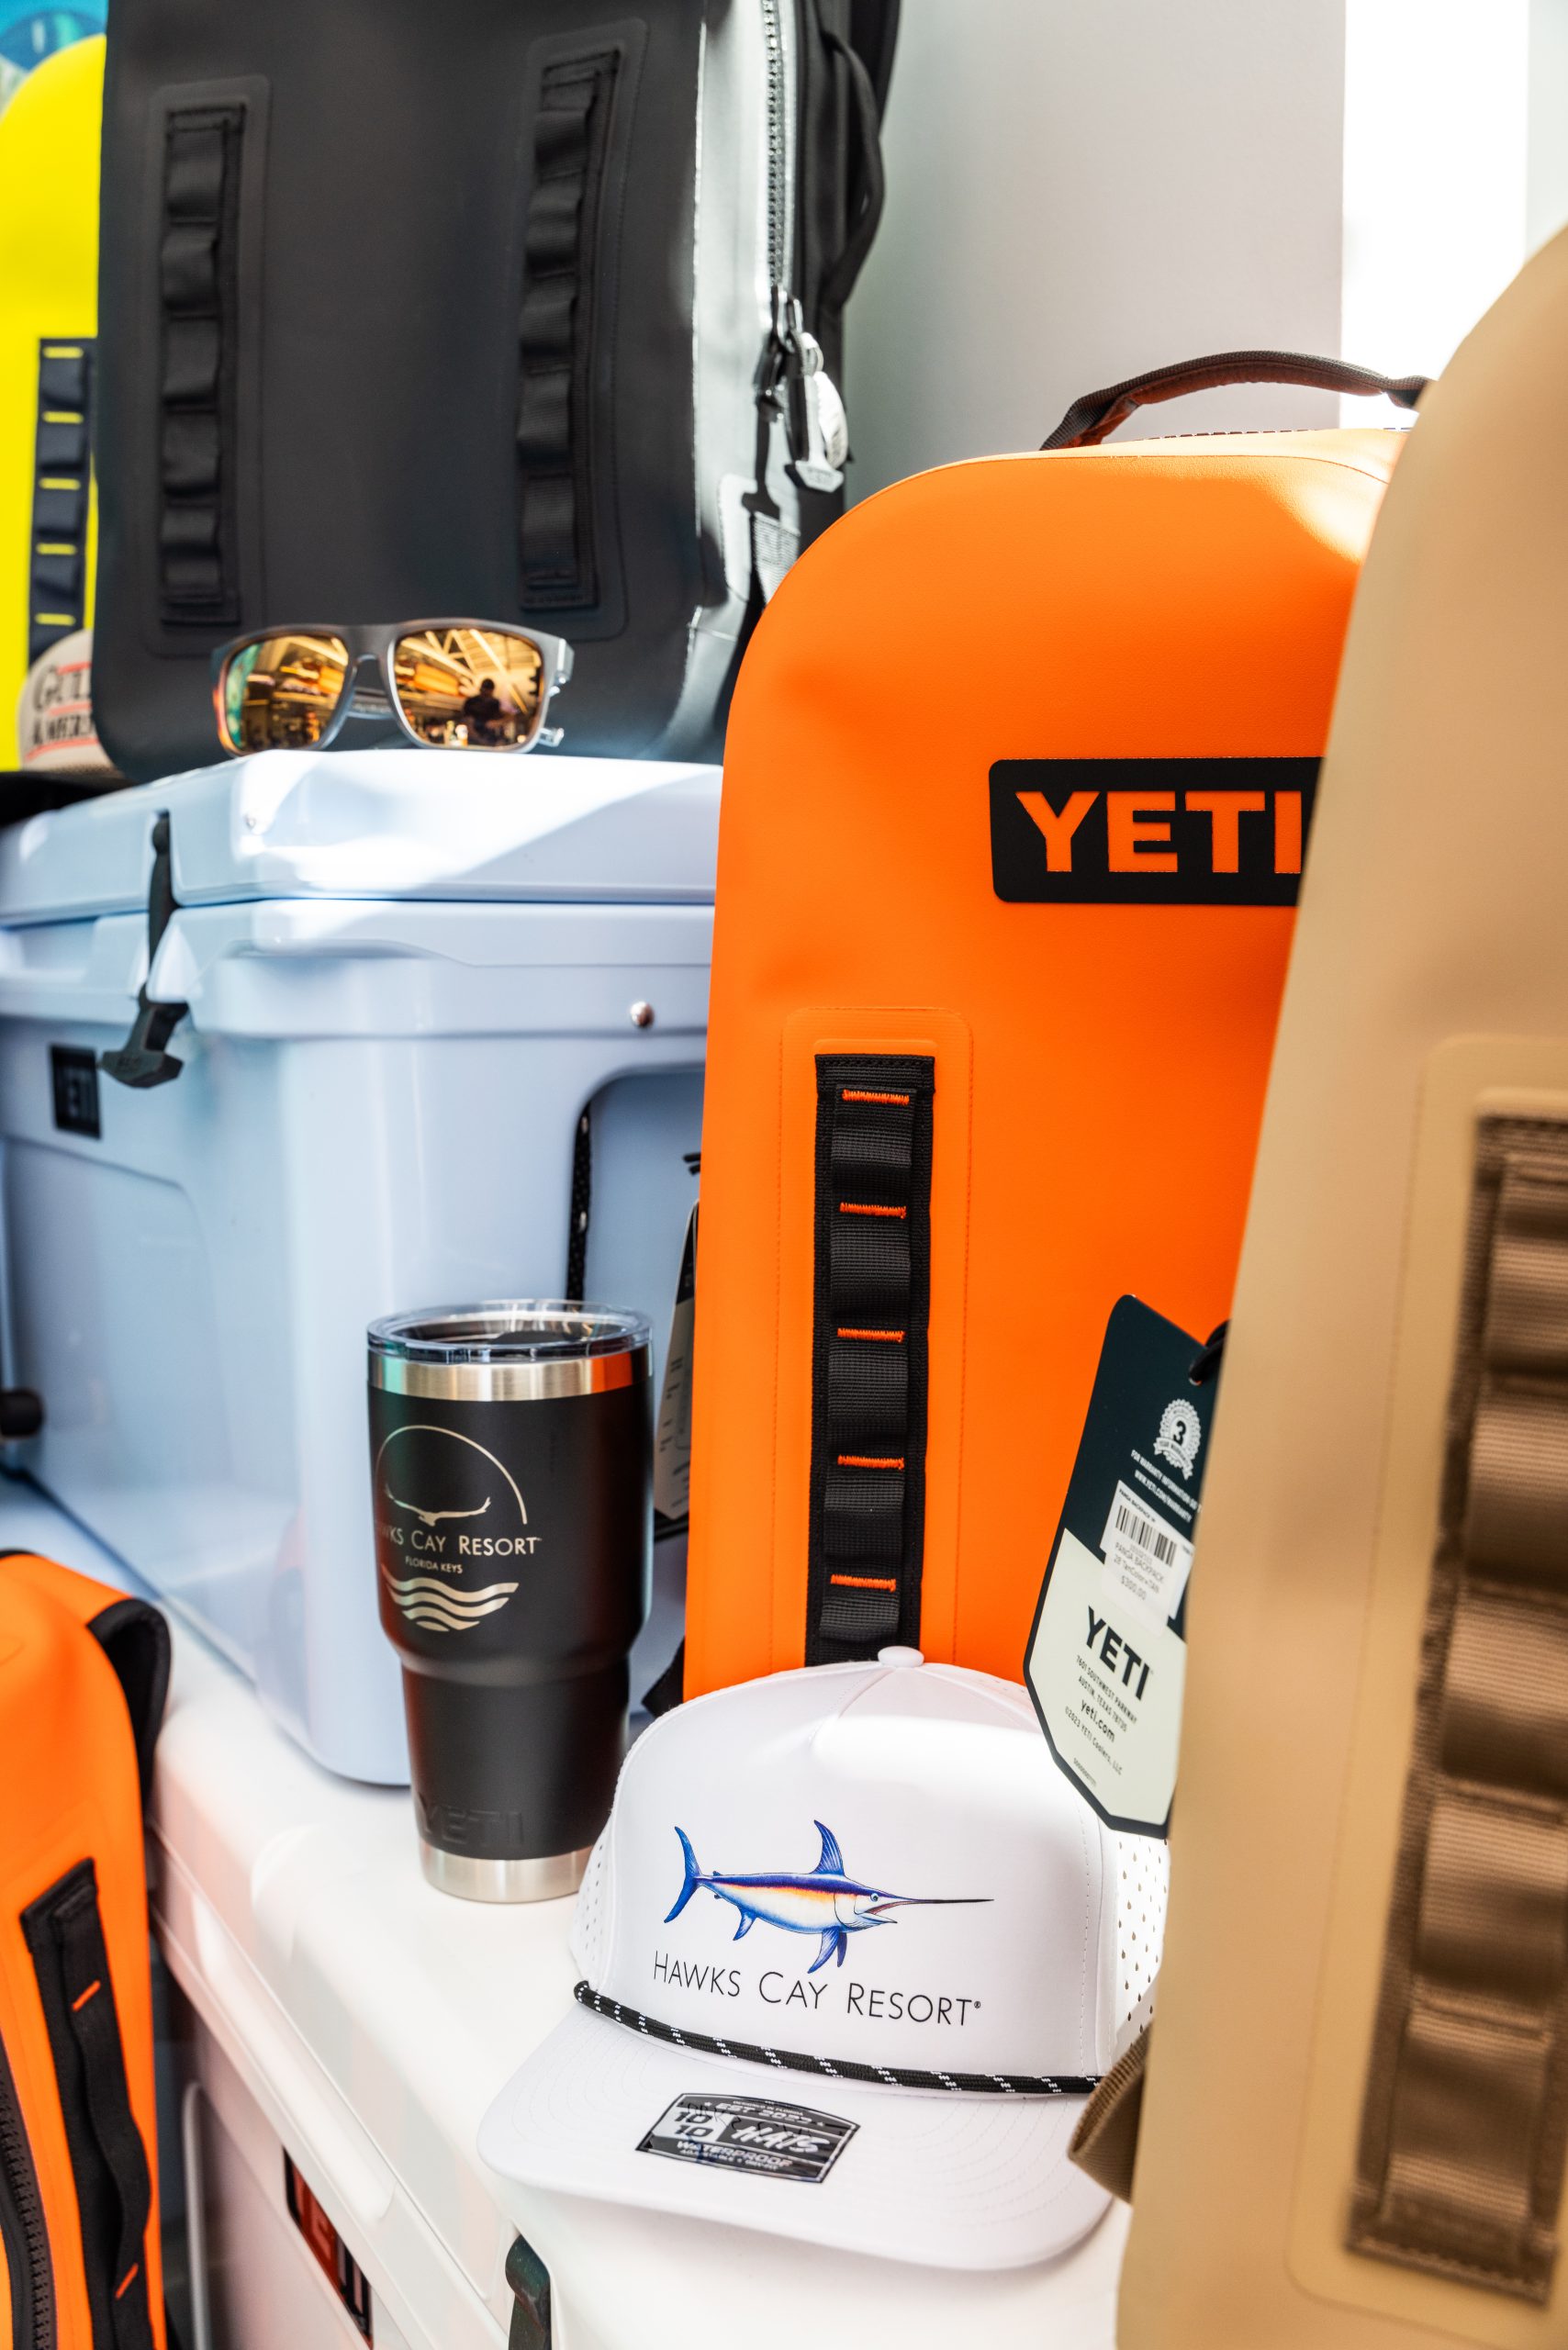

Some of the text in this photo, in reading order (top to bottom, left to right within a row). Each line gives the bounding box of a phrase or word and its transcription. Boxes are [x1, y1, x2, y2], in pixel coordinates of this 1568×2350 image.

[1015, 790, 1302, 874] YETI
[405, 1555, 464, 1574] FLORIDA KEYS
[410, 1530, 447, 1553] CAY
[1086, 1606, 1150, 1701] YETI
[1081, 1698, 1115, 1743] yeti.com
[1087, 1667, 1115, 1700] SOUTHWEST
[1114, 1696, 1137, 1724] PARKWAY
[653, 1950, 742, 1998] HAWKS
[758, 1971, 828, 2009] CAY
[677, 2140, 793, 2167] WATERPROOF
